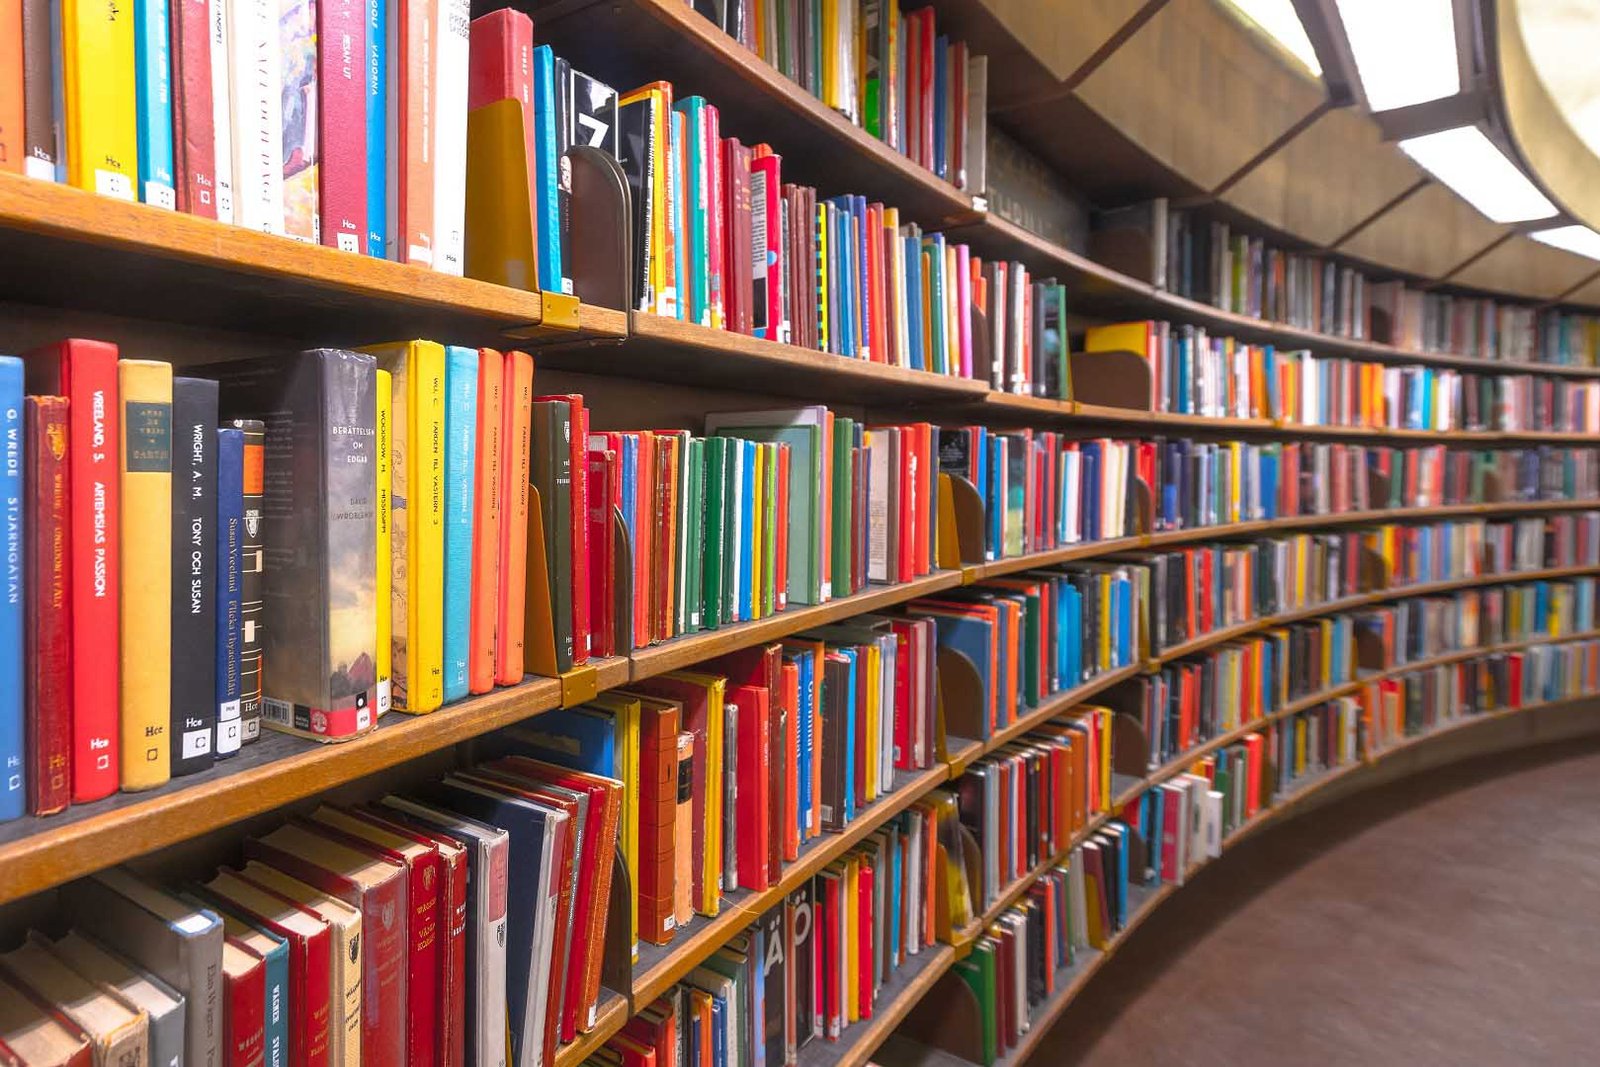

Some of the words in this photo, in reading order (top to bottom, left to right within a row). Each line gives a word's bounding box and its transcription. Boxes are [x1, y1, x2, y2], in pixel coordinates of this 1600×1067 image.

[342, 67, 352, 80] UT
[93, 391, 104, 447] VREELAND,
[7, 428, 18, 476] WREDE
[192, 424, 203, 466] WRIGHT,
[352, 441, 363, 450] OM
[192, 470, 202, 482] A.
[192, 487, 202, 500] M.
[95, 482, 105, 544] ARTEMISIAS
[192, 517, 202, 545] TONY
[95, 549, 105, 597] PASSION
[192, 551, 202, 575] OCH
[192, 580, 201, 614] SUSAN
[186, 717, 202, 728] Hce
